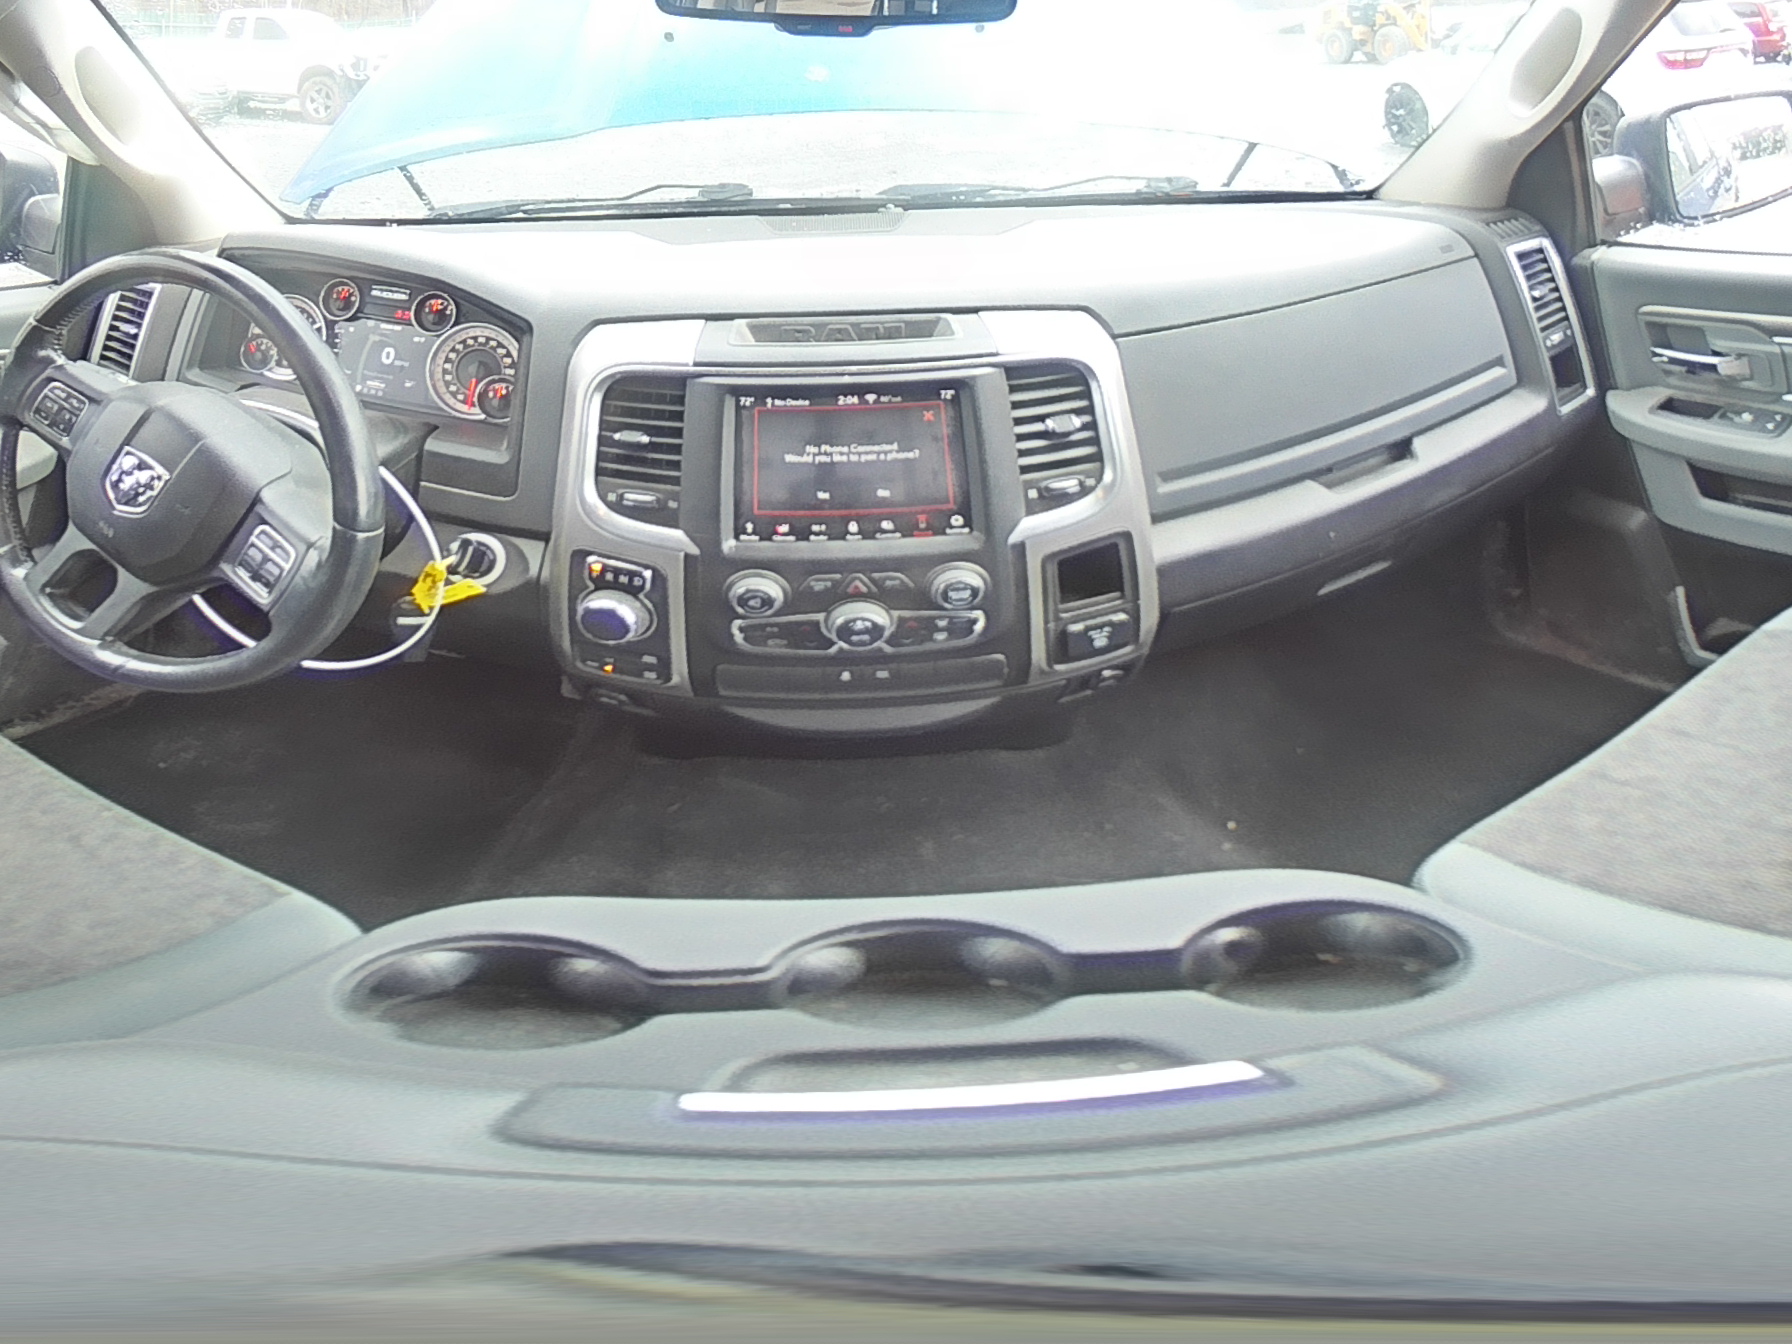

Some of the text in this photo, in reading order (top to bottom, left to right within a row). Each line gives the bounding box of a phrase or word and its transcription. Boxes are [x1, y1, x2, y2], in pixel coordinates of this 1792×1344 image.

[780, 322, 906, 342] RAM
[380, 346, 395, 365] 0
[820, 443, 849, 453] Phone
[850, 441, 899, 453] Connected
